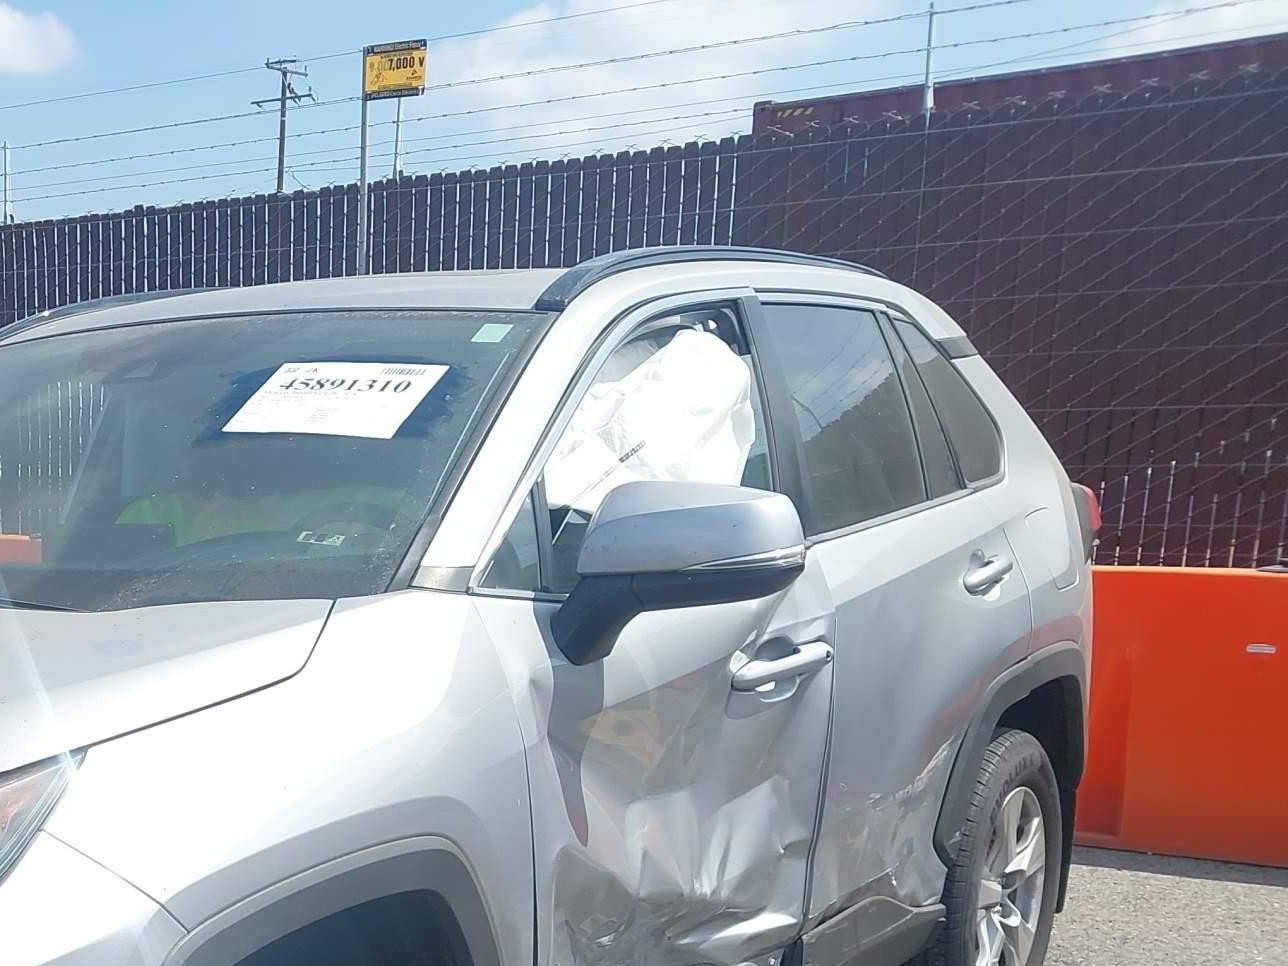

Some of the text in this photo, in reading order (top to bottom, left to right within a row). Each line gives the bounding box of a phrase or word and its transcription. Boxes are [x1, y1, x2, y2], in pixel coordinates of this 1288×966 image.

[388, 57, 425, 72] 7,000 V
[279, 377, 412, 393] 45891310
